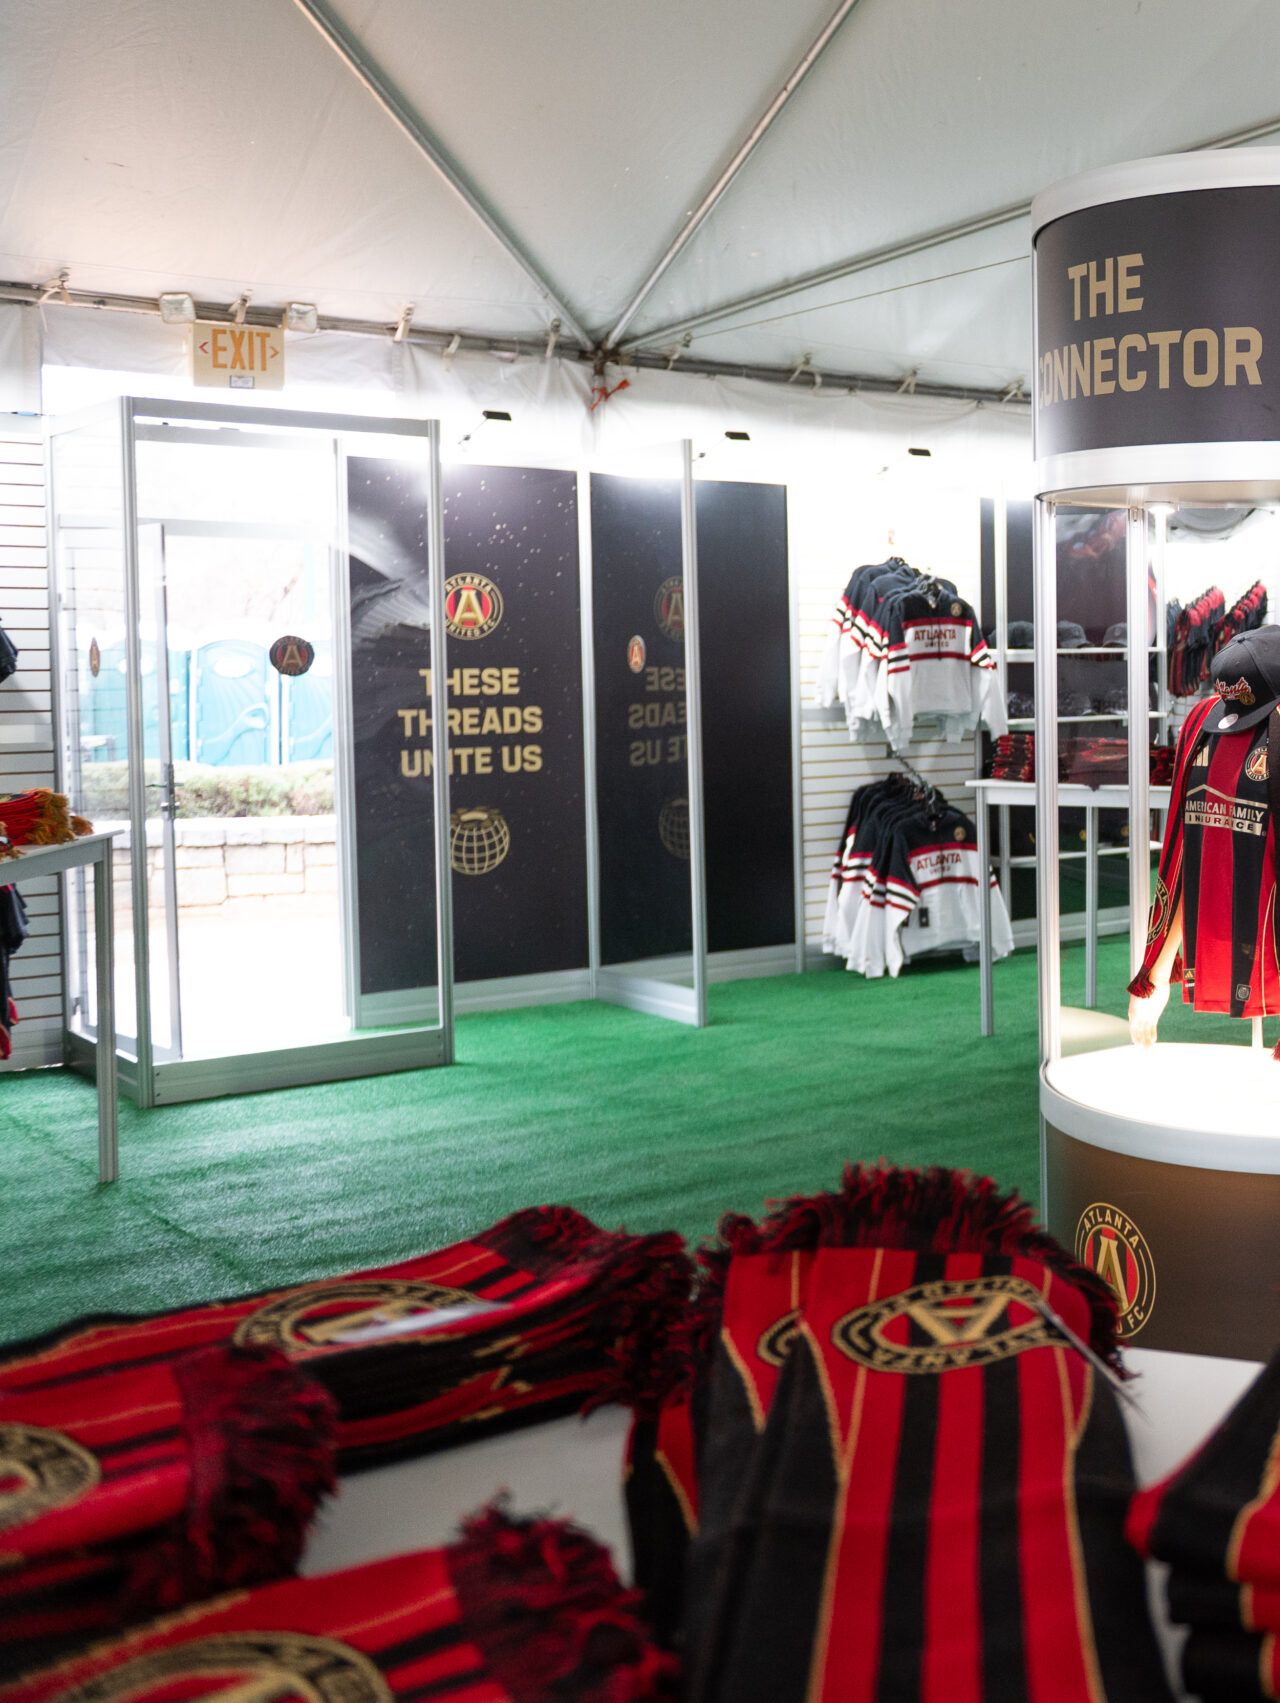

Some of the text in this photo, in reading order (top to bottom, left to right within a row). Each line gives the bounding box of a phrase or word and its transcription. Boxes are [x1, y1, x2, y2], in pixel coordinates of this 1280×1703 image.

[1068, 253, 1144, 321] THE
[212, 328, 271, 371] EXIT
[914, 629, 957, 640] ATLANTA
[419, 667, 520, 696] THESE
[398, 705, 543, 737] THREADS
[401, 745, 543, 777] UNITE US
[1185, 800, 1226, 815] AMERICAN
[1188, 814, 1254, 831] INURACE
[1083, 1208, 1140, 1249] ATLANTA
[1126, 1305, 1144, 1329] FC
